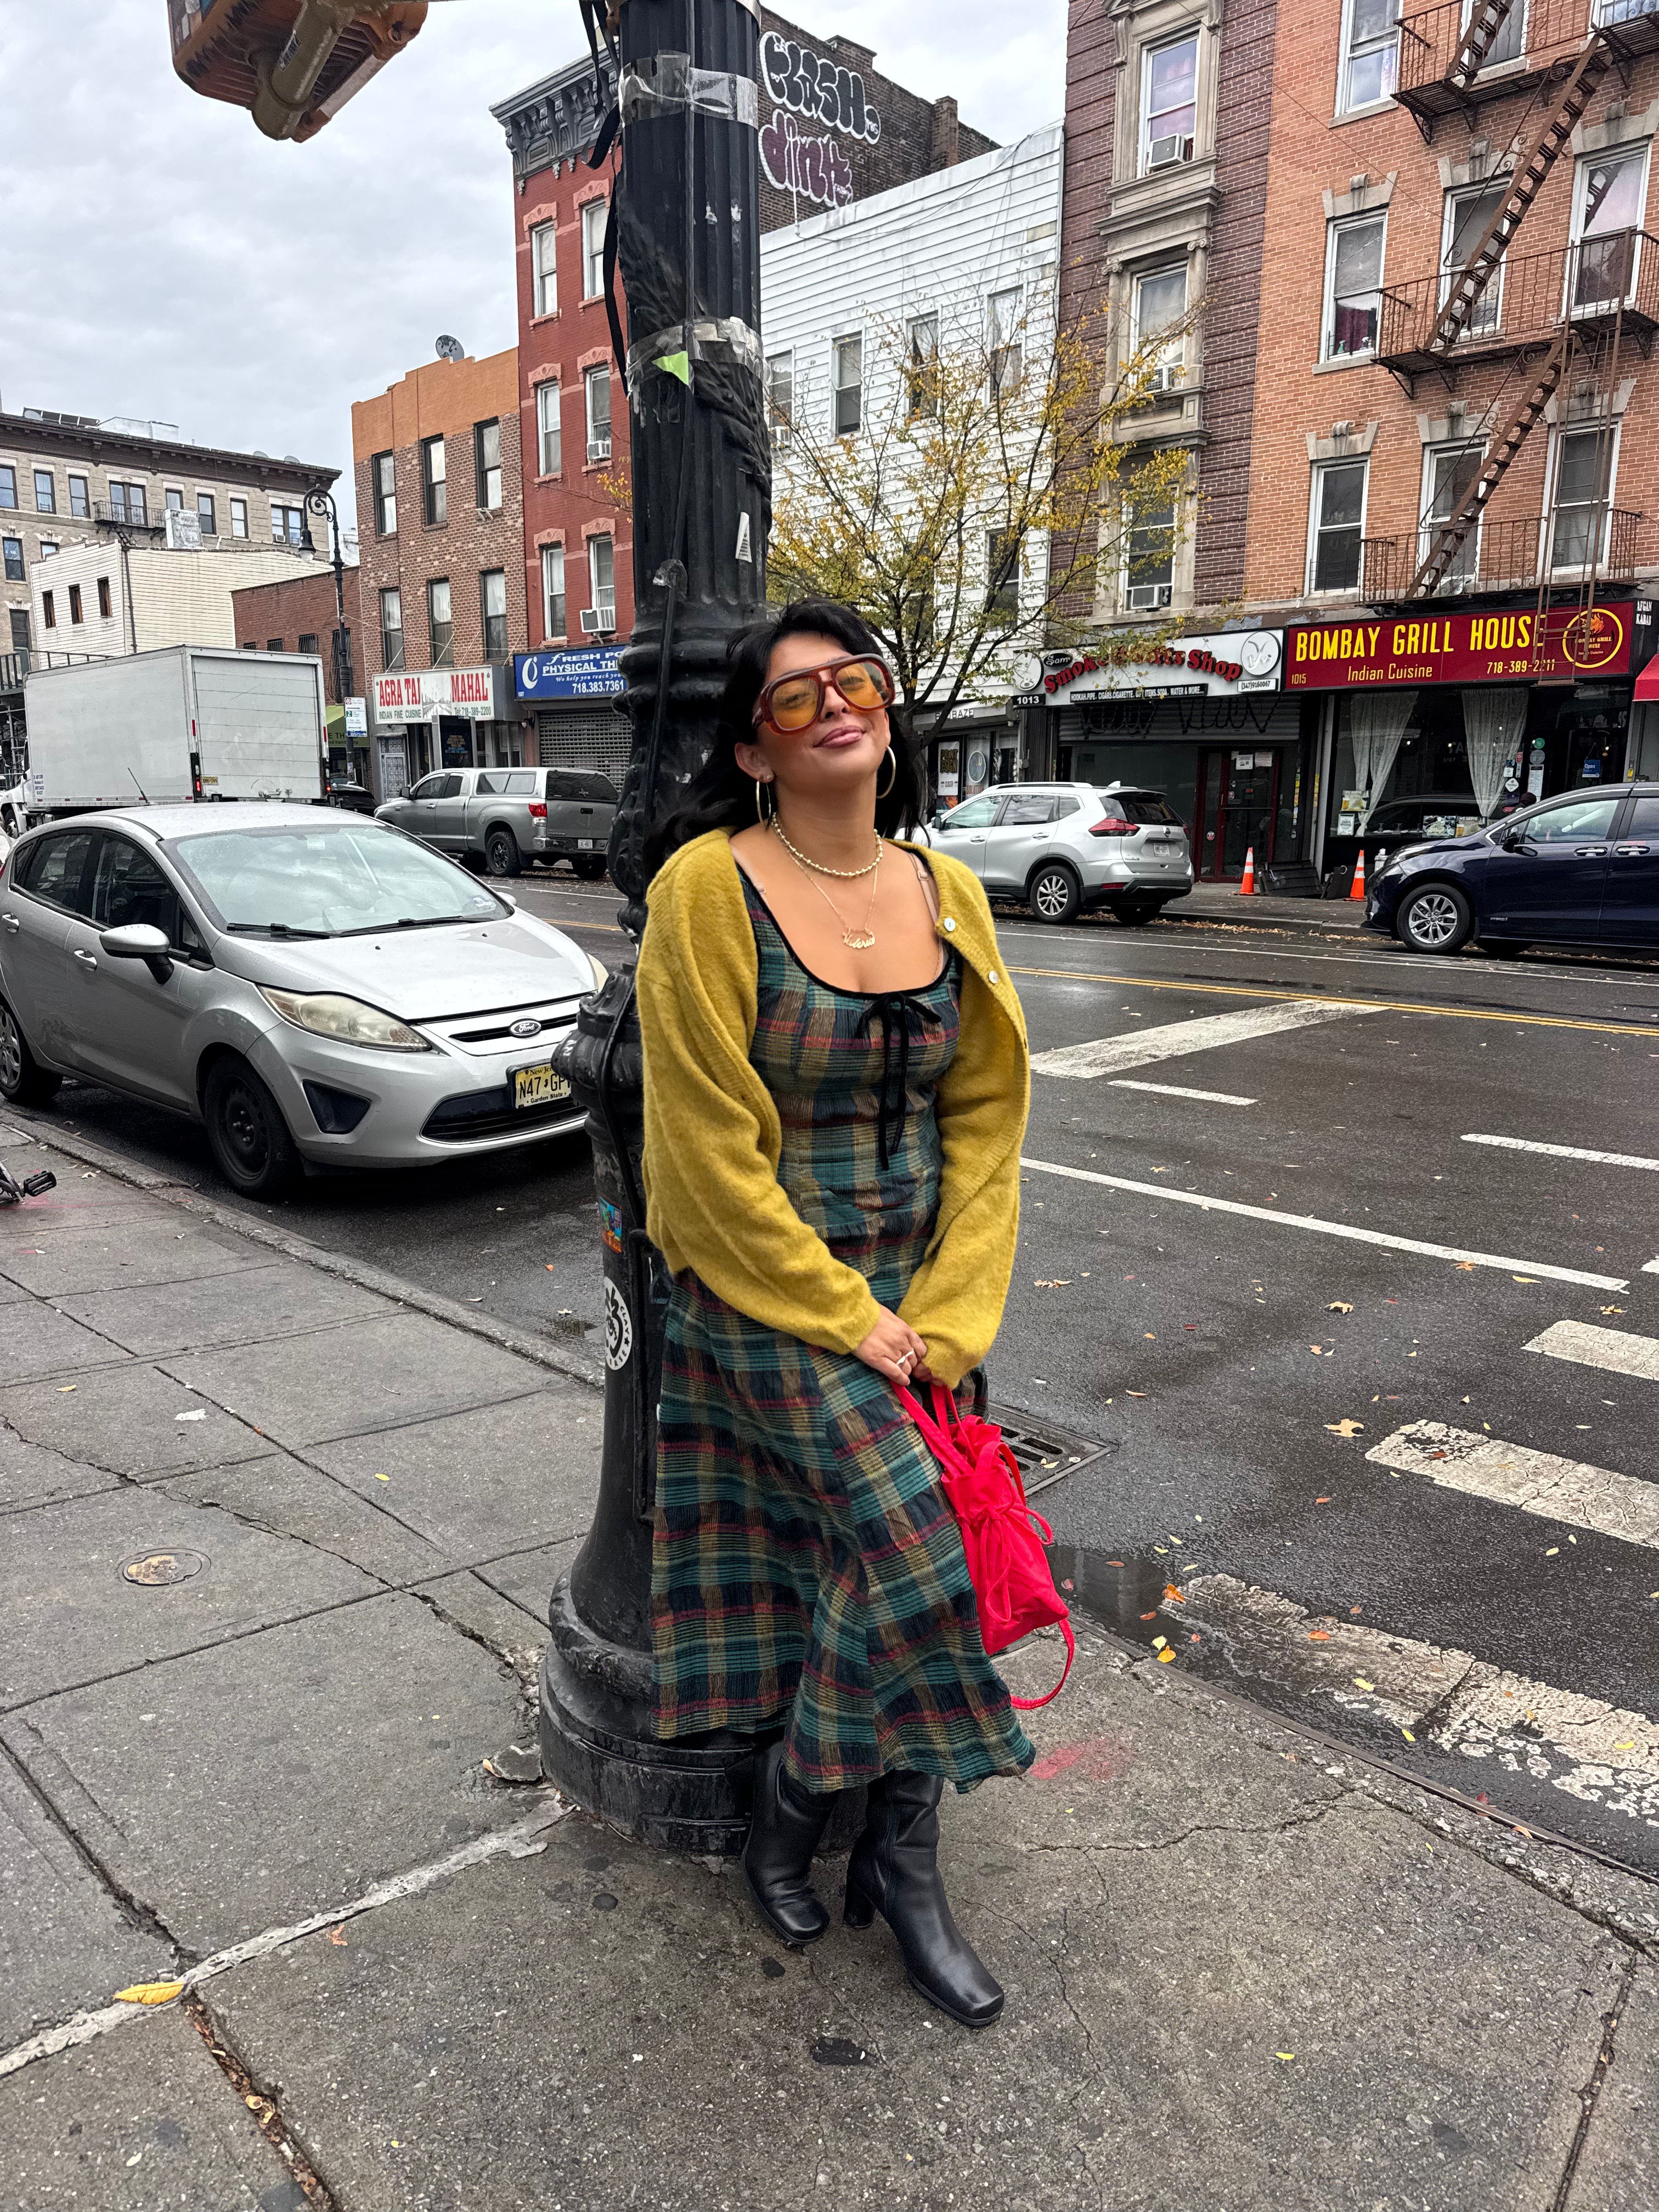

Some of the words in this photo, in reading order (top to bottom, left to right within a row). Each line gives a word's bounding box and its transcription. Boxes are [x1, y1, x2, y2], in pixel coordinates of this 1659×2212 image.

[1296, 627, 1380, 662] BOMBAY
[1393, 621, 1454, 655] GRILL
[543, 662, 597, 674] PHYSICAL
[1187, 649, 1243, 682] Shop
[1347, 665, 1383, 681] Indian
[1388, 663, 1432, 680] Cuisine
[572, 679, 624, 693] 718.383.7361
[1291, 674, 1307, 684] 1015
[380, 679, 403, 707] AGRA
[404, 678, 421, 706] TAJ
[451, 673, 488, 703] MAHAL
[1017, 696, 1039, 705] 1013
[379, 710, 392, 719] INDIAN
[394, 710, 403, 719] FINE
[405, 709, 421, 718] CUISINE
[518, 1023, 535, 1032] Ford
[520, 1076, 541, 1099] N47
